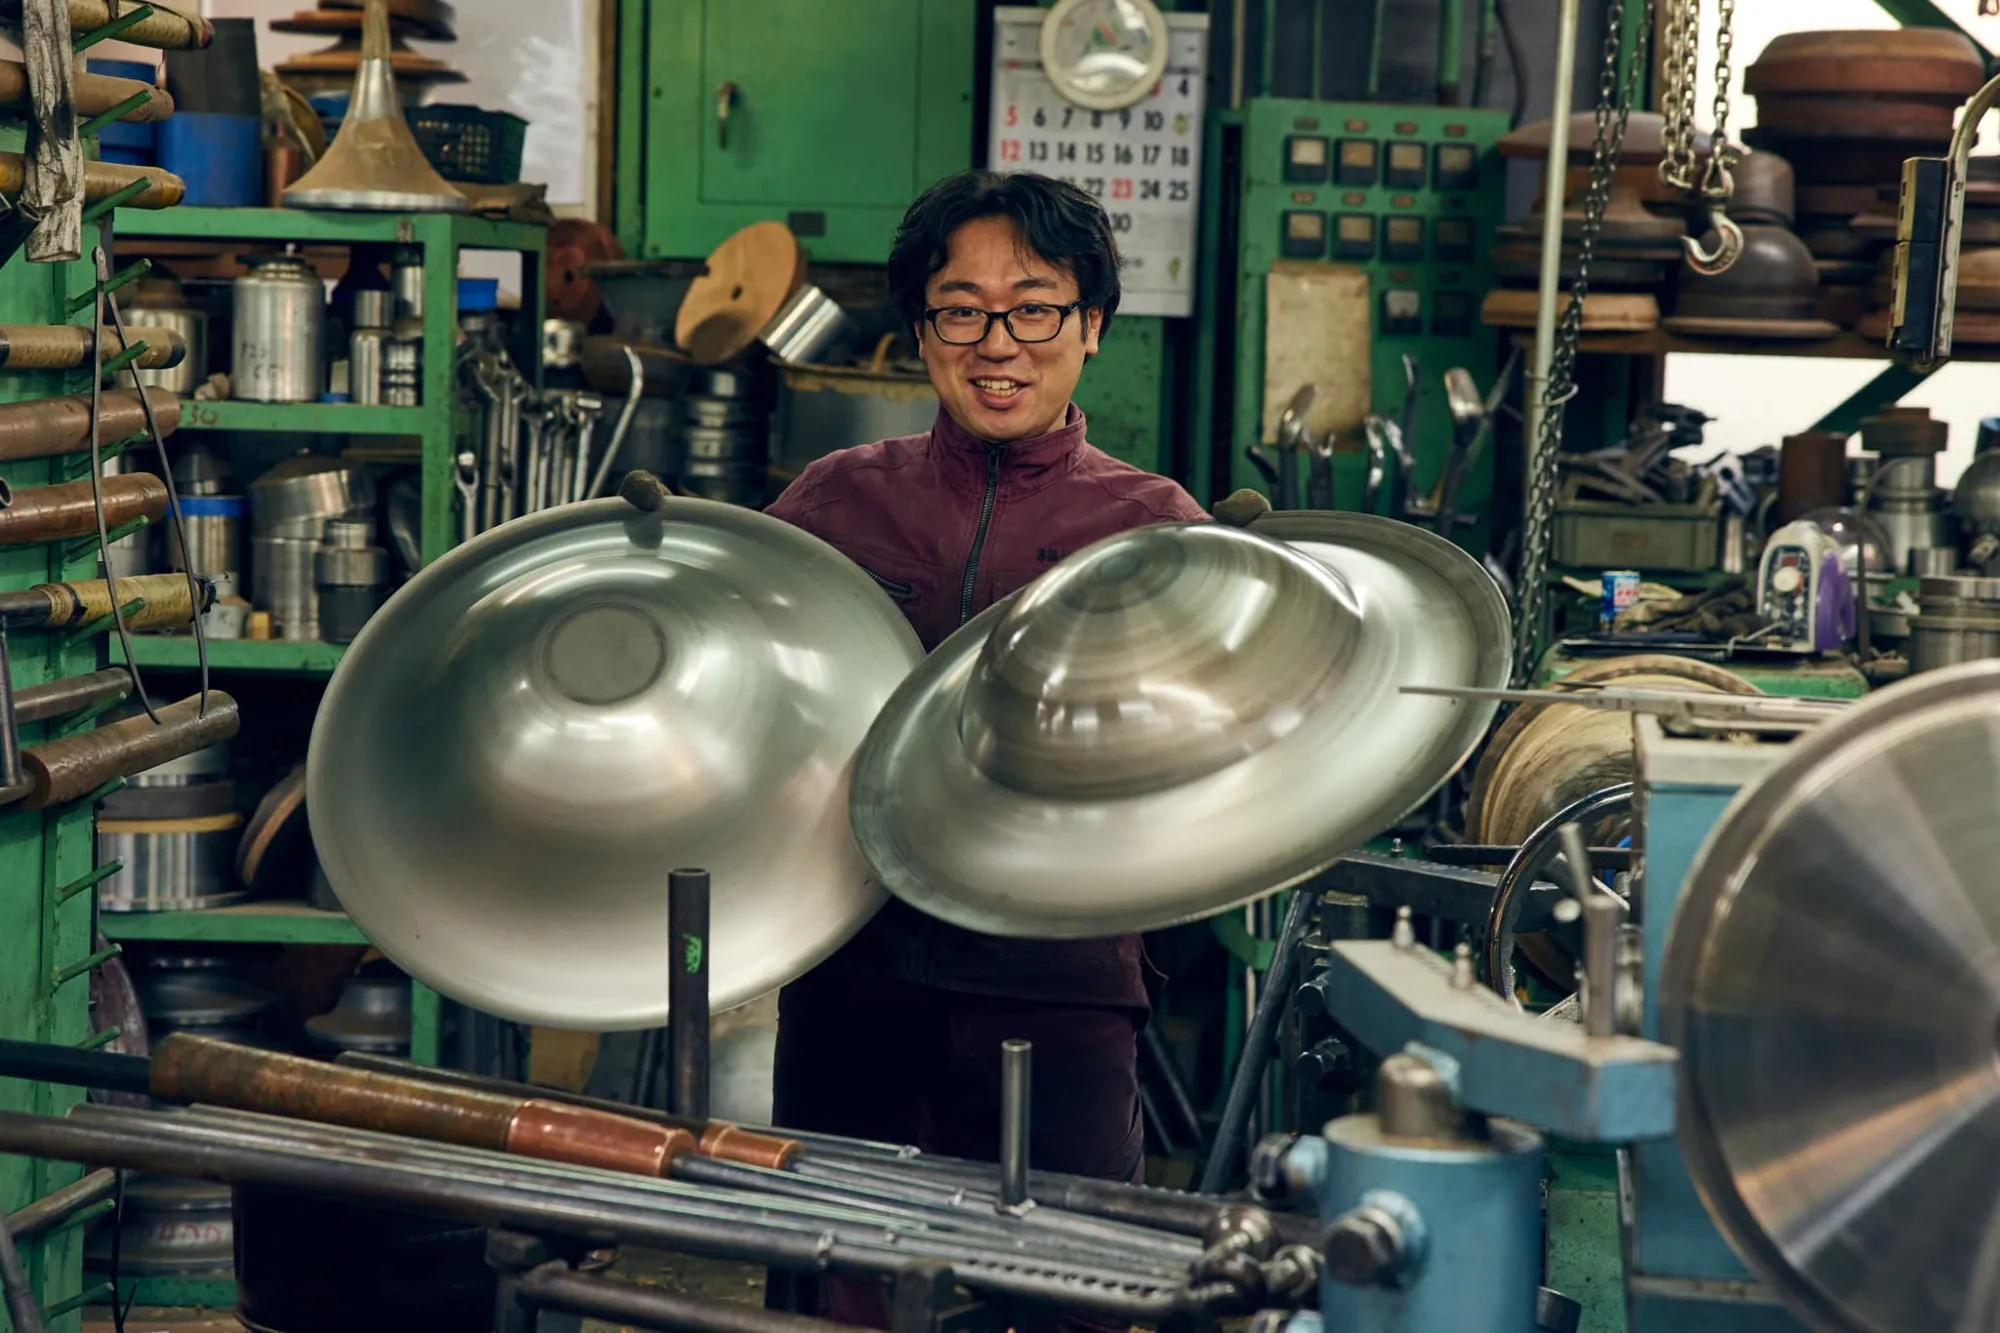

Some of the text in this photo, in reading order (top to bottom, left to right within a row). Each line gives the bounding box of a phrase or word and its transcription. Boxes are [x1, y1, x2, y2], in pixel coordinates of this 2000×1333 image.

[1177, 76, 1189, 96] 4
[1006, 105, 1164, 131] 5 6 7 8 9 10
[1001, 139, 1189, 167] 12 13 14 15 16 17 18
[1111, 177, 1133, 199] 23
[1140, 179, 1160, 200] 24
[1168, 180, 1189, 201] 25
[1112, 212, 1131, 233] 30
[180, 403, 218, 426] 30
